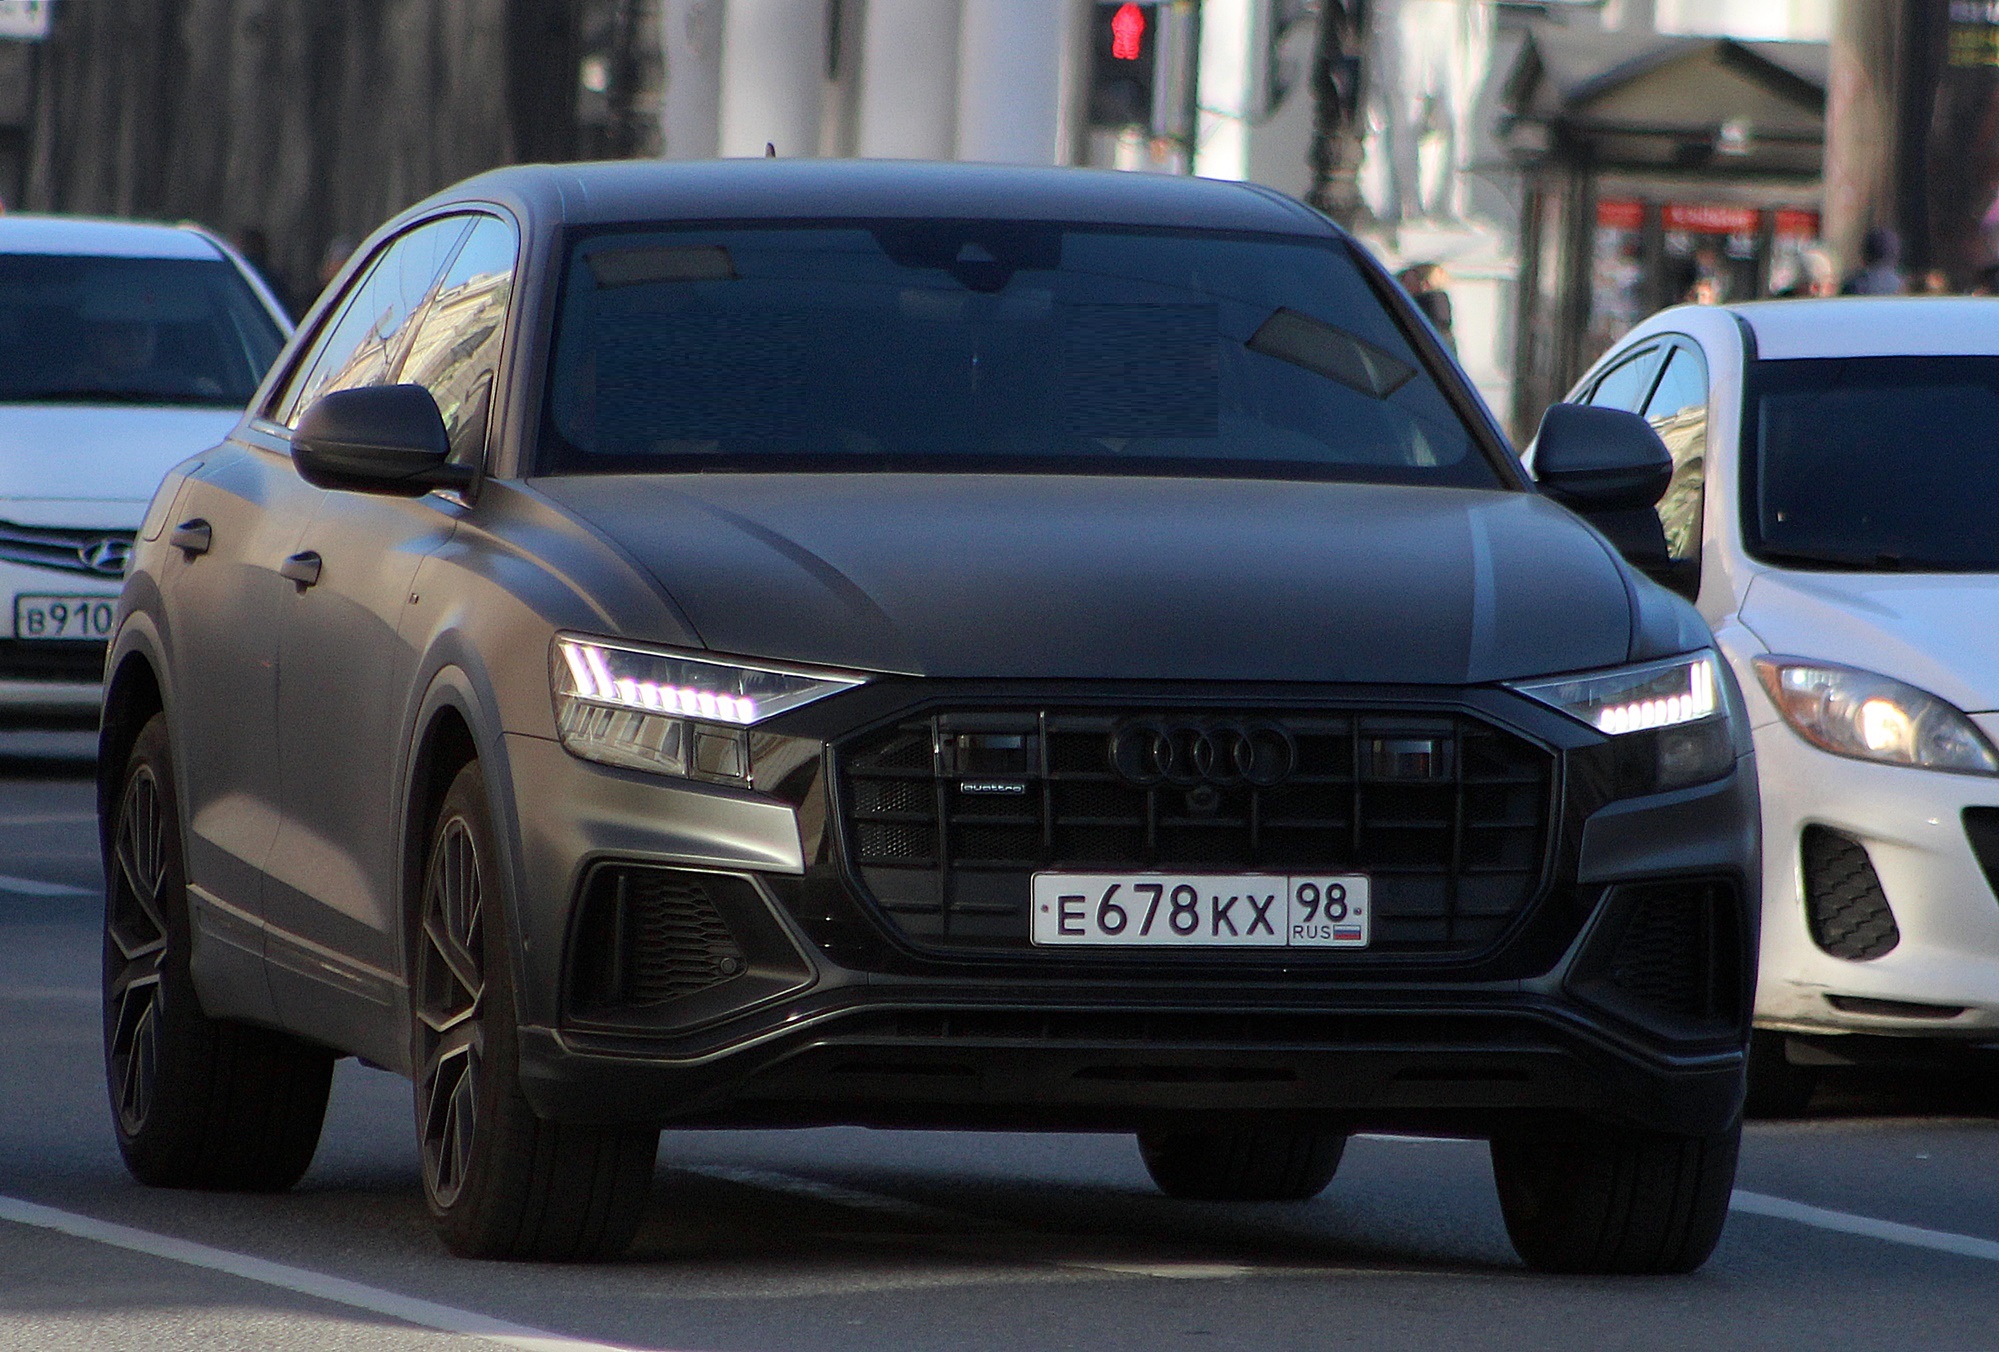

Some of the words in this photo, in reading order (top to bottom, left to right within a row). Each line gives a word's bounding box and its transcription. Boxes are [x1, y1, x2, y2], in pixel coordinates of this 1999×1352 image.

[962, 783, 1023, 793] quattro
[1295, 882, 1348, 923] 98
[1293, 924, 1331, 940] RUS
